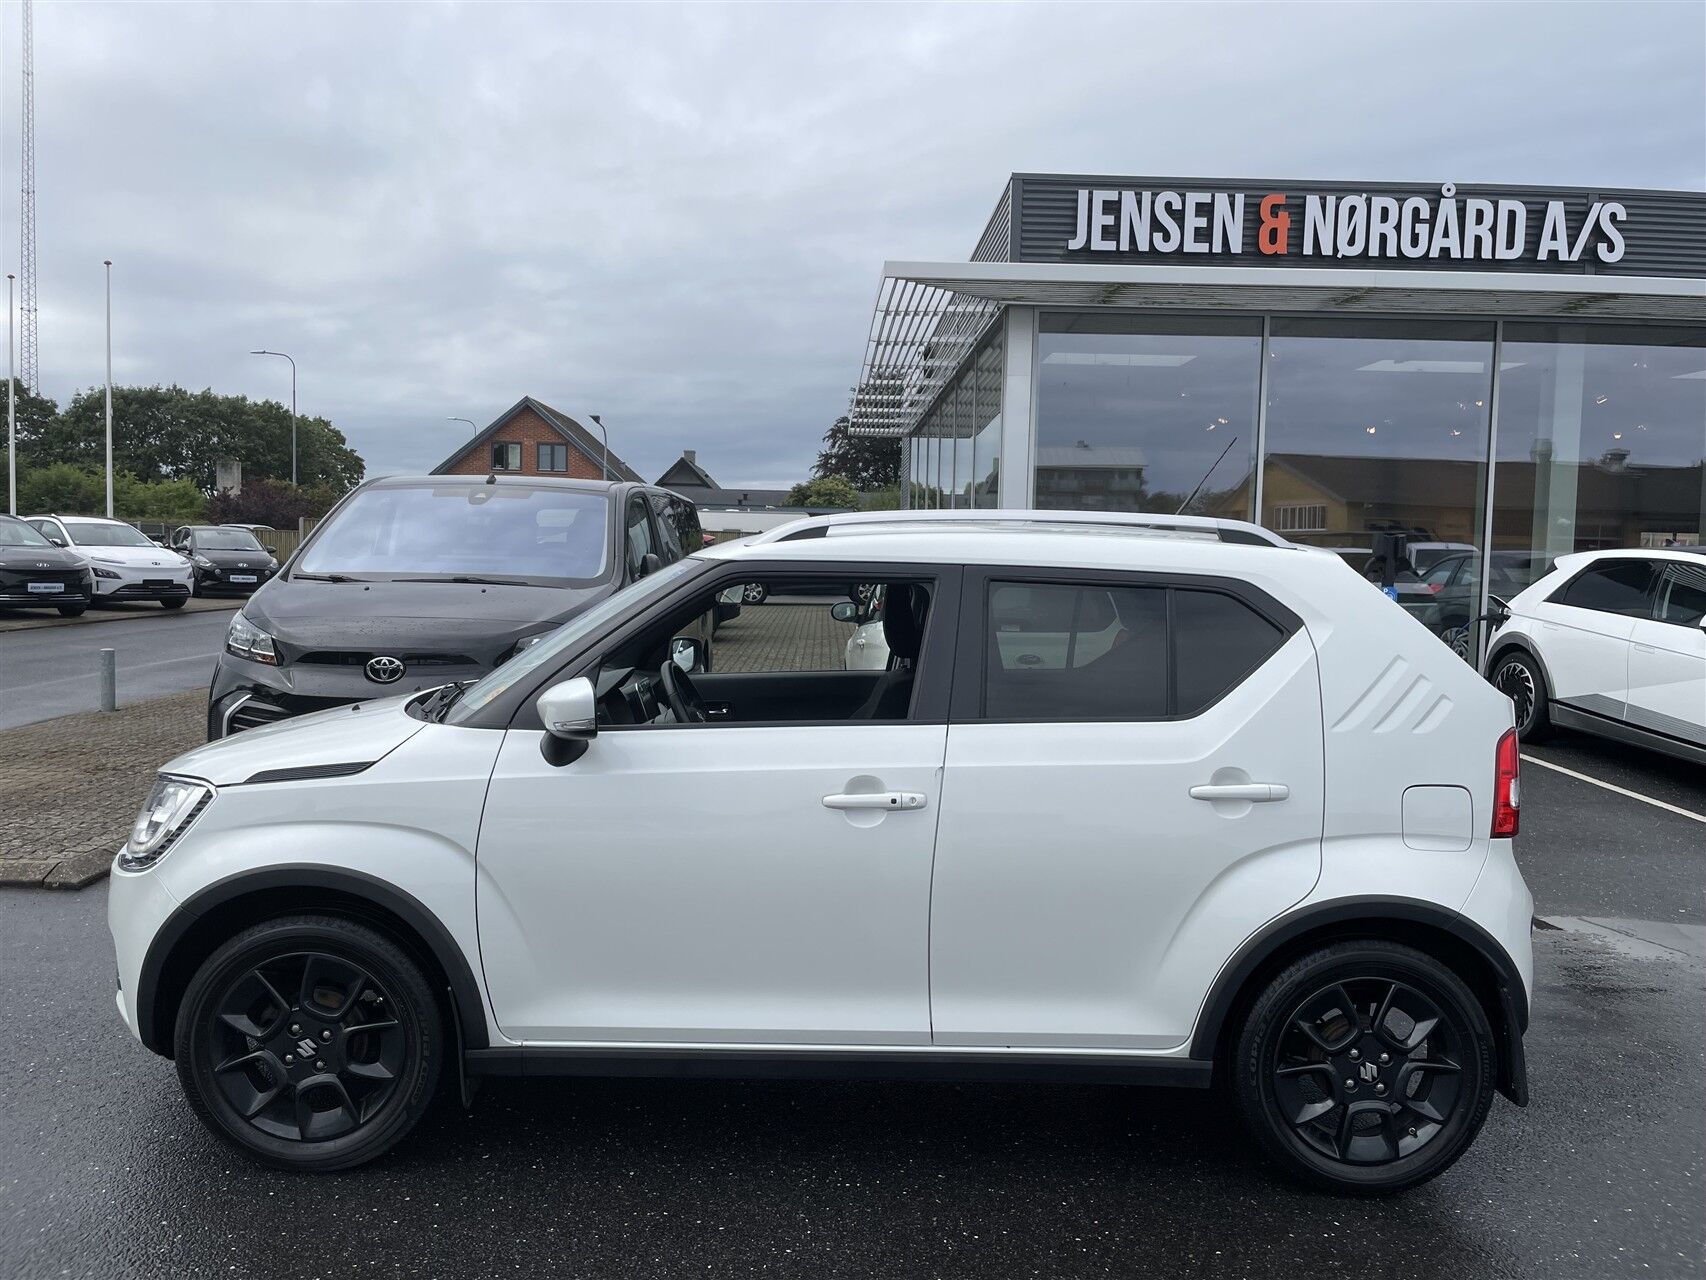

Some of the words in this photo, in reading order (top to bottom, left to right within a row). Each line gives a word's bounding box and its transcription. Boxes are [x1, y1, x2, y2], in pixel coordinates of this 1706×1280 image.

[1067, 189, 1245, 254] JENSEN
[1258, 194, 1291, 254] &
[1302, 182, 1528, 260] NØRGÅRD
[1536, 200, 1628, 263] A/S
